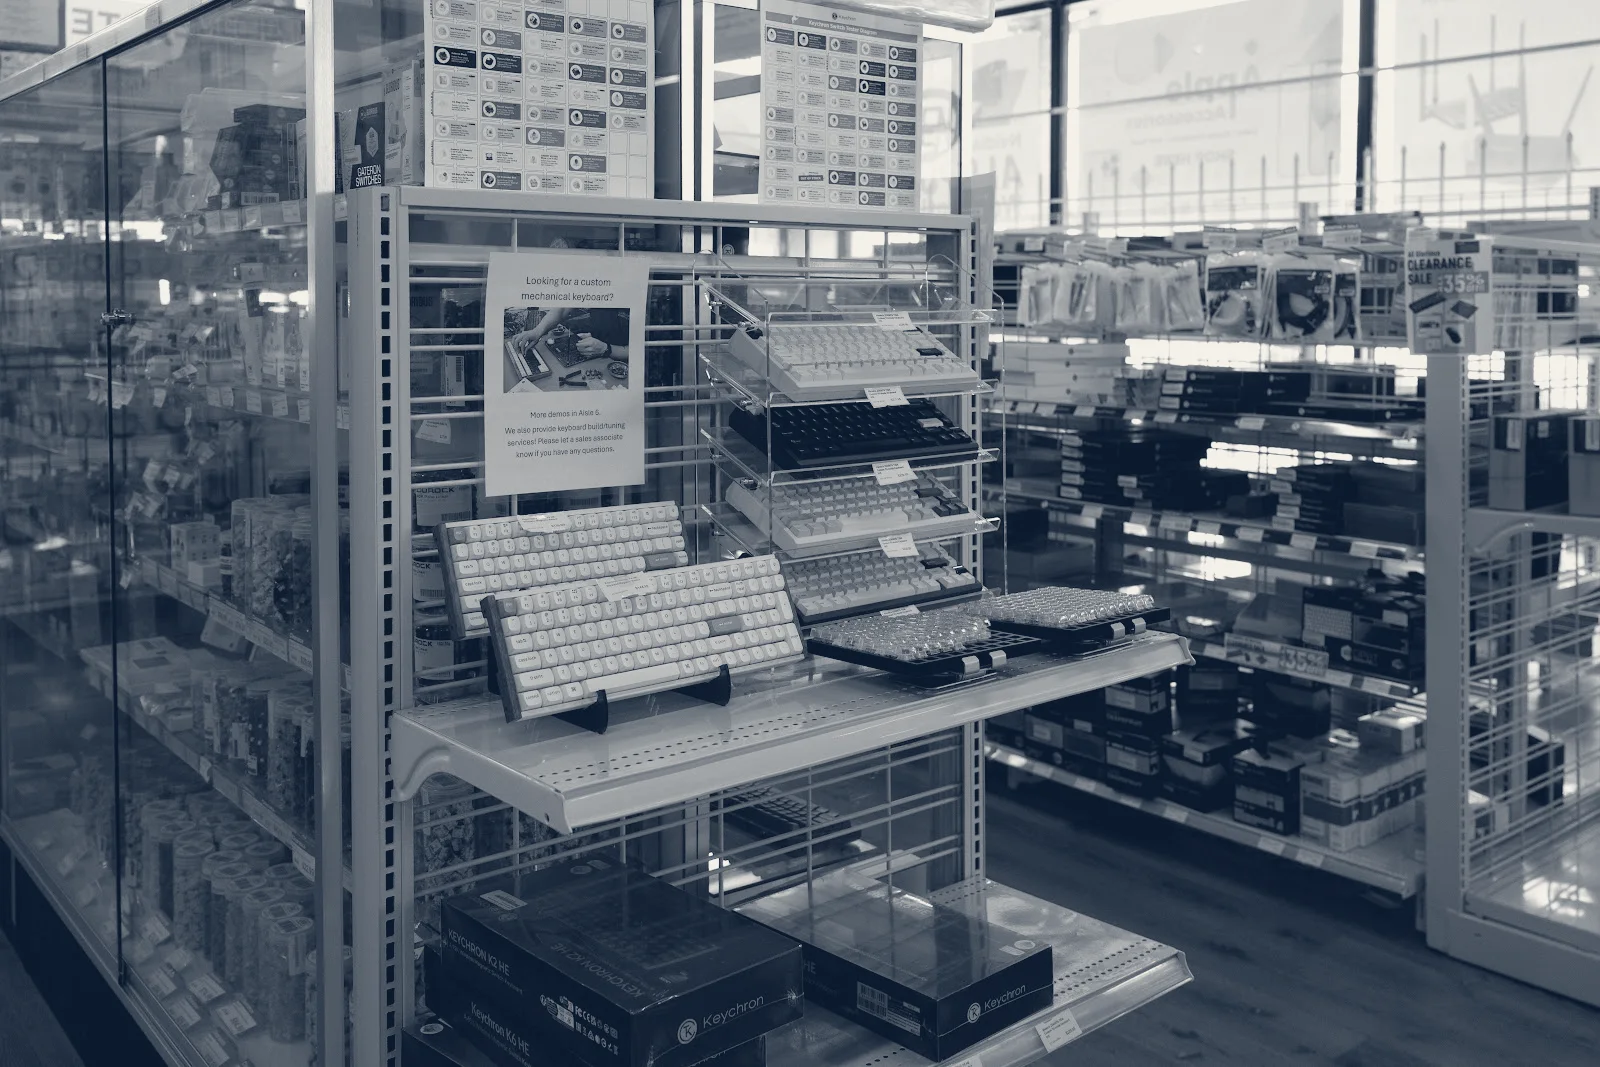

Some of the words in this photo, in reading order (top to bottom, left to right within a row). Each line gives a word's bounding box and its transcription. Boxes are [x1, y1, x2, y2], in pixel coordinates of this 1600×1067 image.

[808, 19, 830, 28] Keychron
[830, 23, 845, 31] Switch
[860, 28, 878, 36] Diagram
[358, 164, 381, 177] GATERON
[356, 174, 382, 187] SWITCHES
[1407, 257, 1472, 271] CLEARANCE
[526, 276, 559, 287] Looking
[560, 276, 572, 286] for
[581, 278, 611, 286] custom
[1408, 273, 1432, 285] SALE
[521, 292, 571, 301] mechanical
[572, 293, 614, 303] keyboard?
[530, 411, 547, 419] More
[548, 410, 570, 418] demos
[578, 409, 594, 417] Aisle
[504, 427, 516, 435] We
[517, 426, 531, 434] also
[532, 424, 557, 434] provide
[557, 423, 586, 433] keyboard
[587, 422, 626, 431] build/tuning
[507, 438, 537, 447] services!
[538, 437, 559, 445] Please
[560, 436, 569, 444] let
[575, 435, 592, 443] sales
[593, 433, 624, 442] associate
[515, 450, 533, 459] know
[534, 449, 539, 457] if
[540, 450, 552, 458] you
[552, 448, 568, 456] have
[569, 448, 581, 456] any
[581, 445, 615, 455] questions.
[448, 928, 487, 962] KEYCHRON
[488, 954, 498, 969] K2
[499, 960, 510, 977] HE
[551, 942, 568, 955] HE
[565, 950, 584, 963] K2
[580, 960, 646, 998] KEYCHRON
[984, 983, 1026, 1012] Keychron
[703, 995, 764, 1029] Keychron
[470, 1001, 505, 1039] Keychron
[506, 1027, 517, 1047] K6
[518, 1036, 530, 1058] HE
